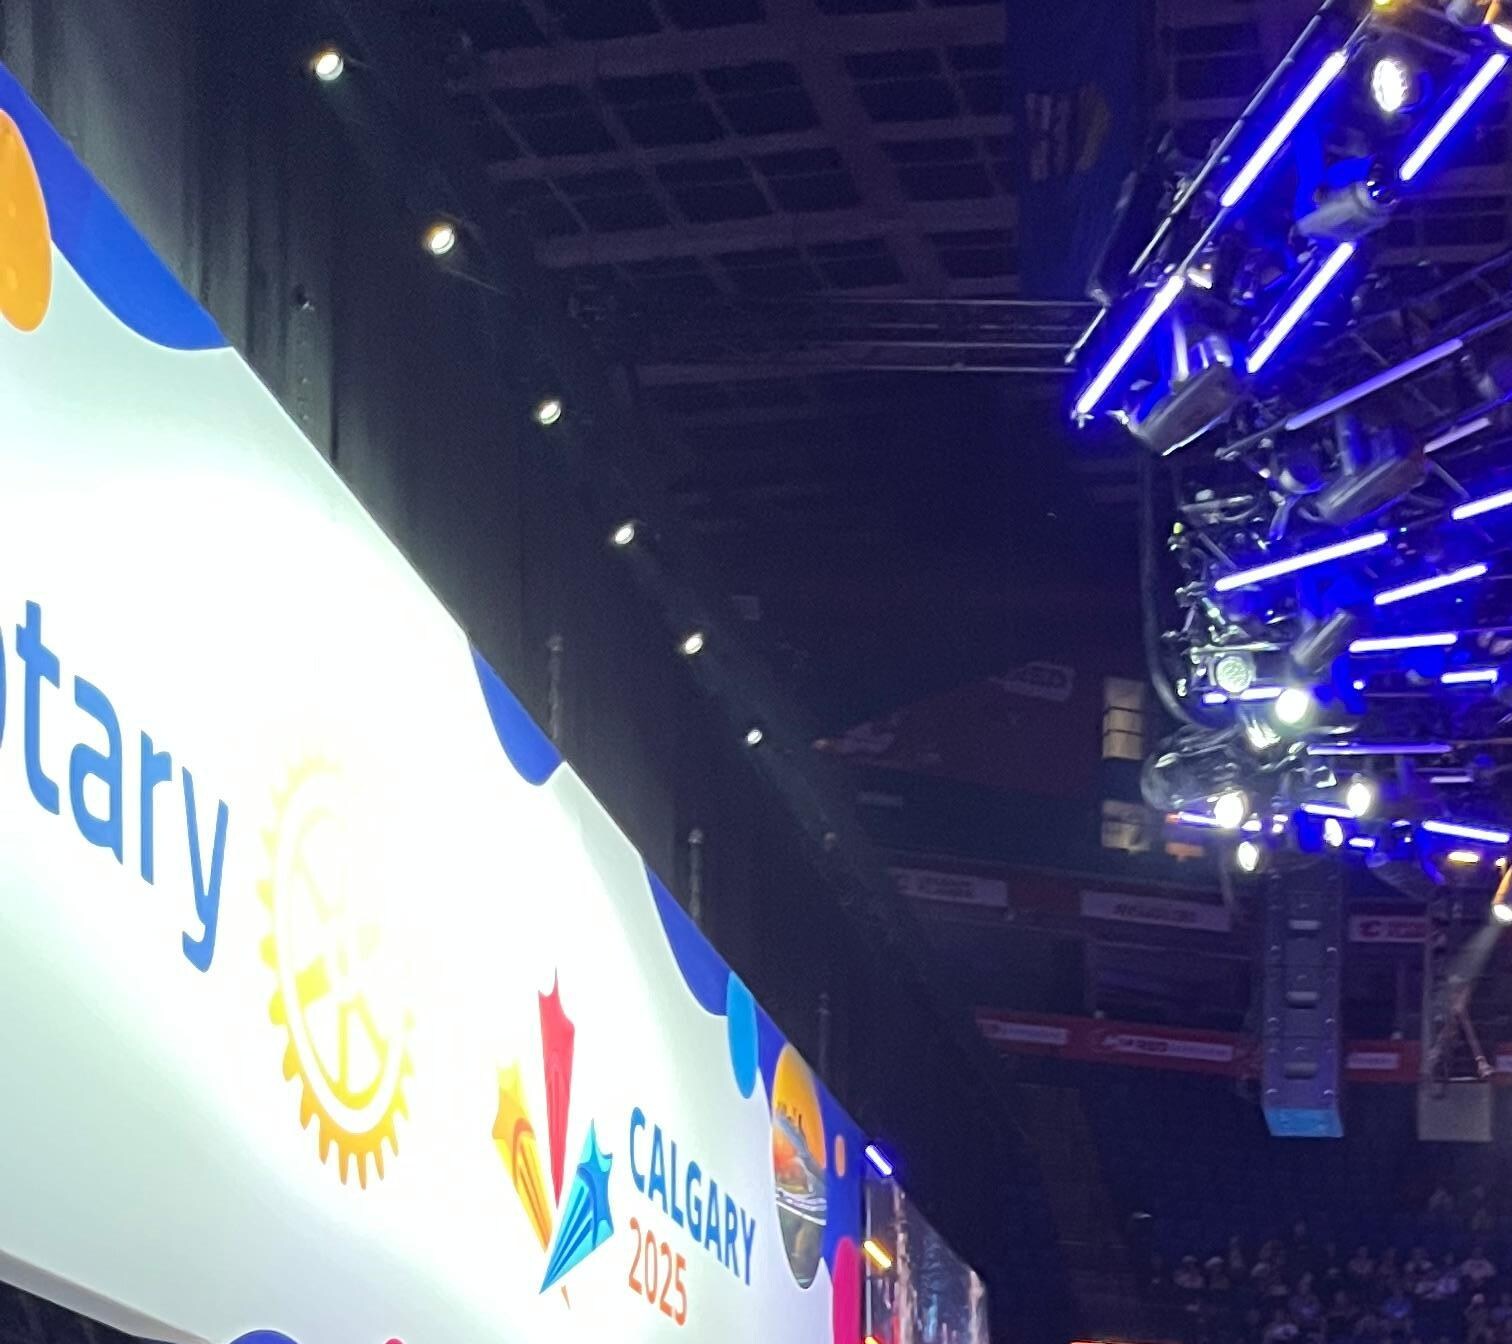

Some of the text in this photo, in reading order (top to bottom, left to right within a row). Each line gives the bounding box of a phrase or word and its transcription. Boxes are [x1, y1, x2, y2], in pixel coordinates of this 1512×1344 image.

[0, 599, 229, 973] tary
[628, 1216, 688, 1327] 2025
[629, 1106, 756, 1287] CALGARY
